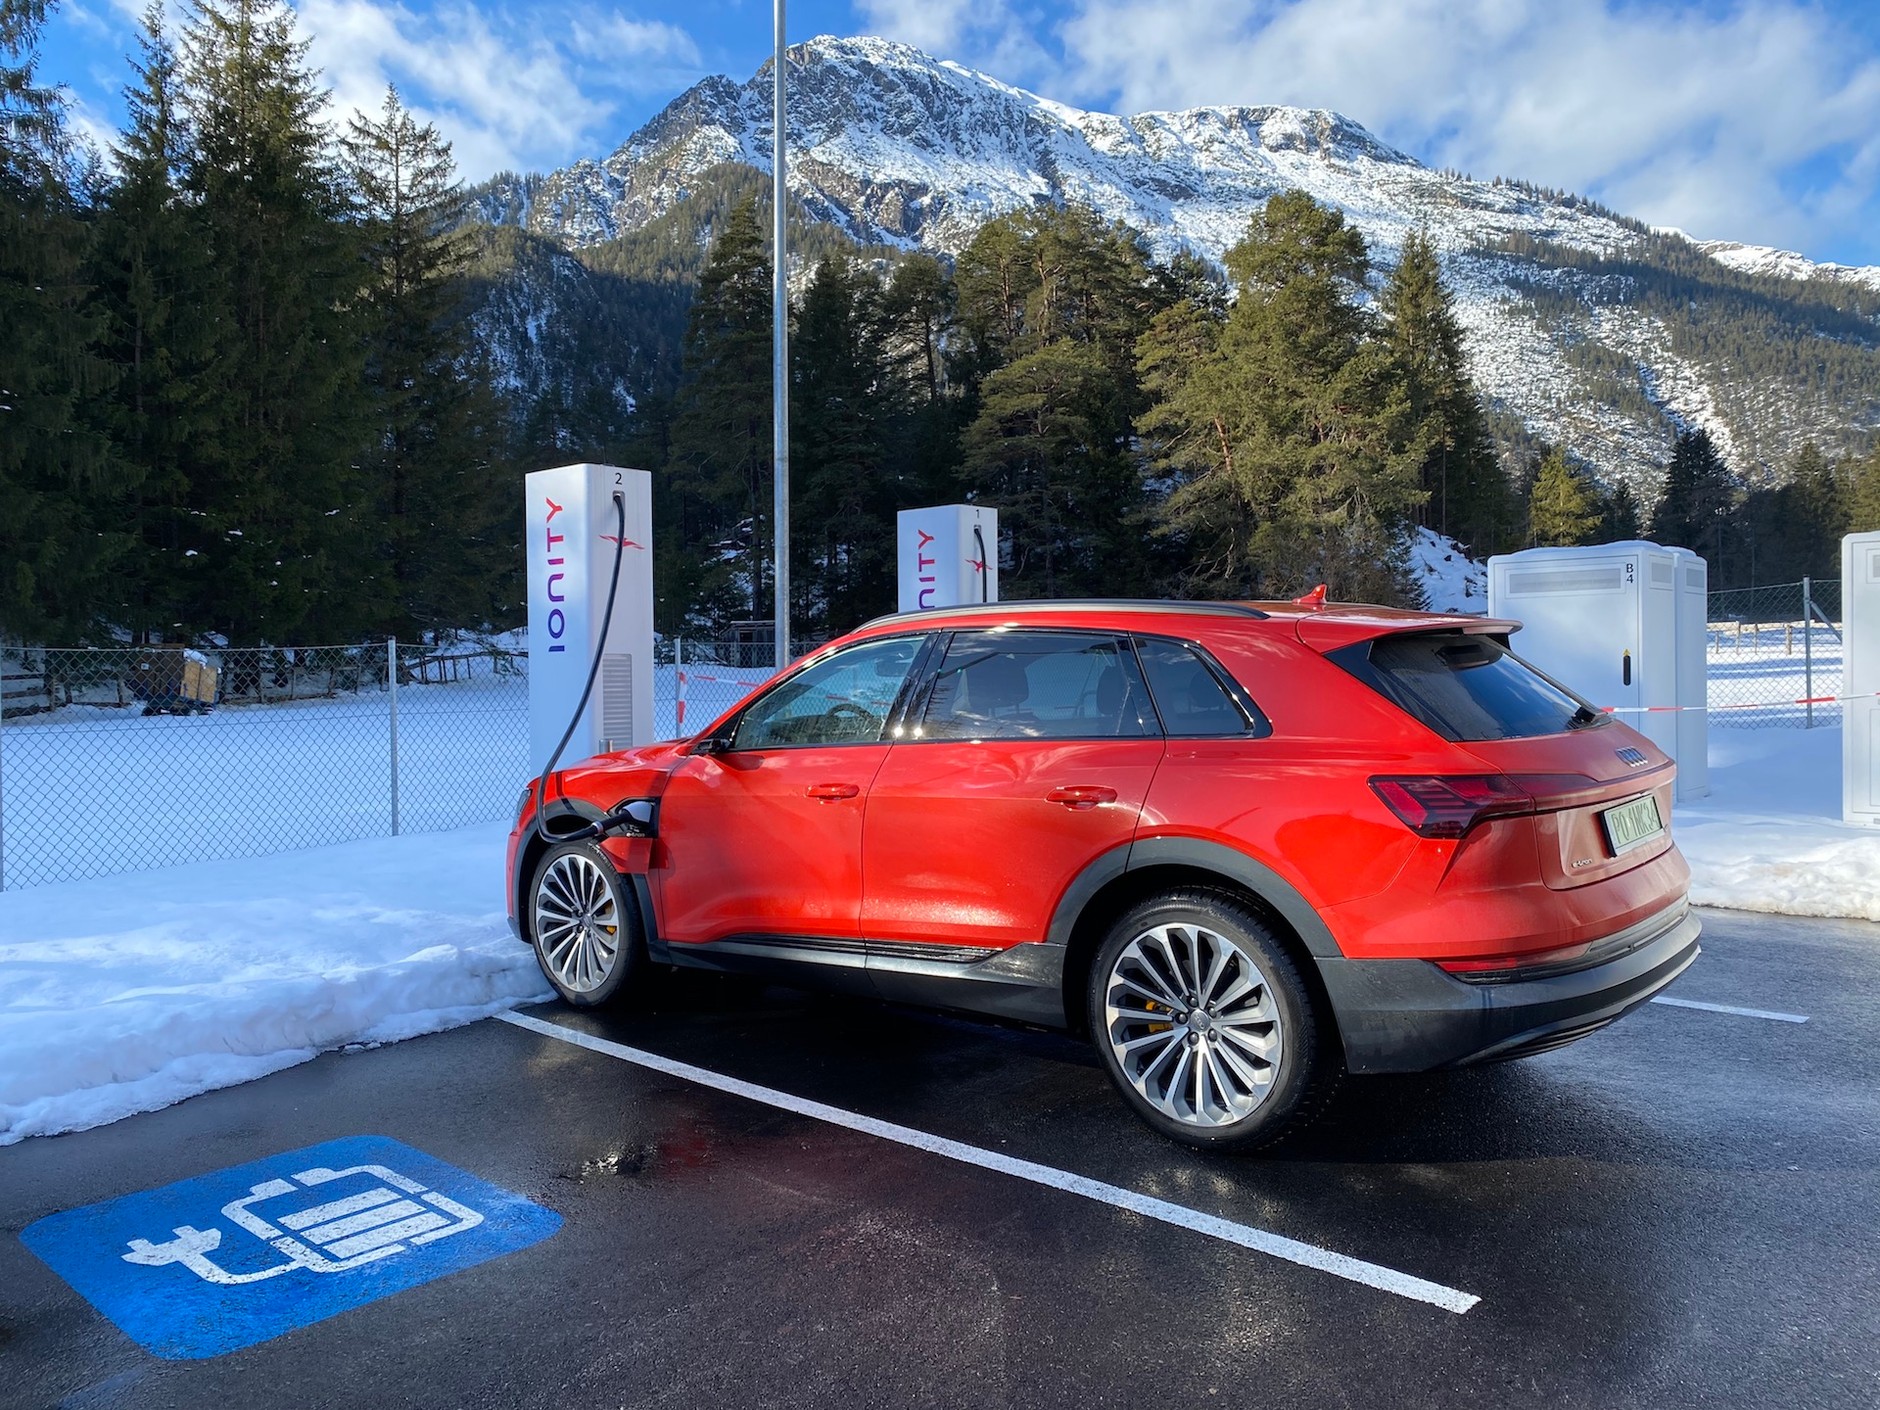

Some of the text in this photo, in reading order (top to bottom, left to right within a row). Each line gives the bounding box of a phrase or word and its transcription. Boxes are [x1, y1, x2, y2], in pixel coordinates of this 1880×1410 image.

[615, 472, 623, 485] 2
[975, 509, 980, 519] 1
[545, 496, 565, 652] IONITY
[1611, 811, 1630, 844] PO
